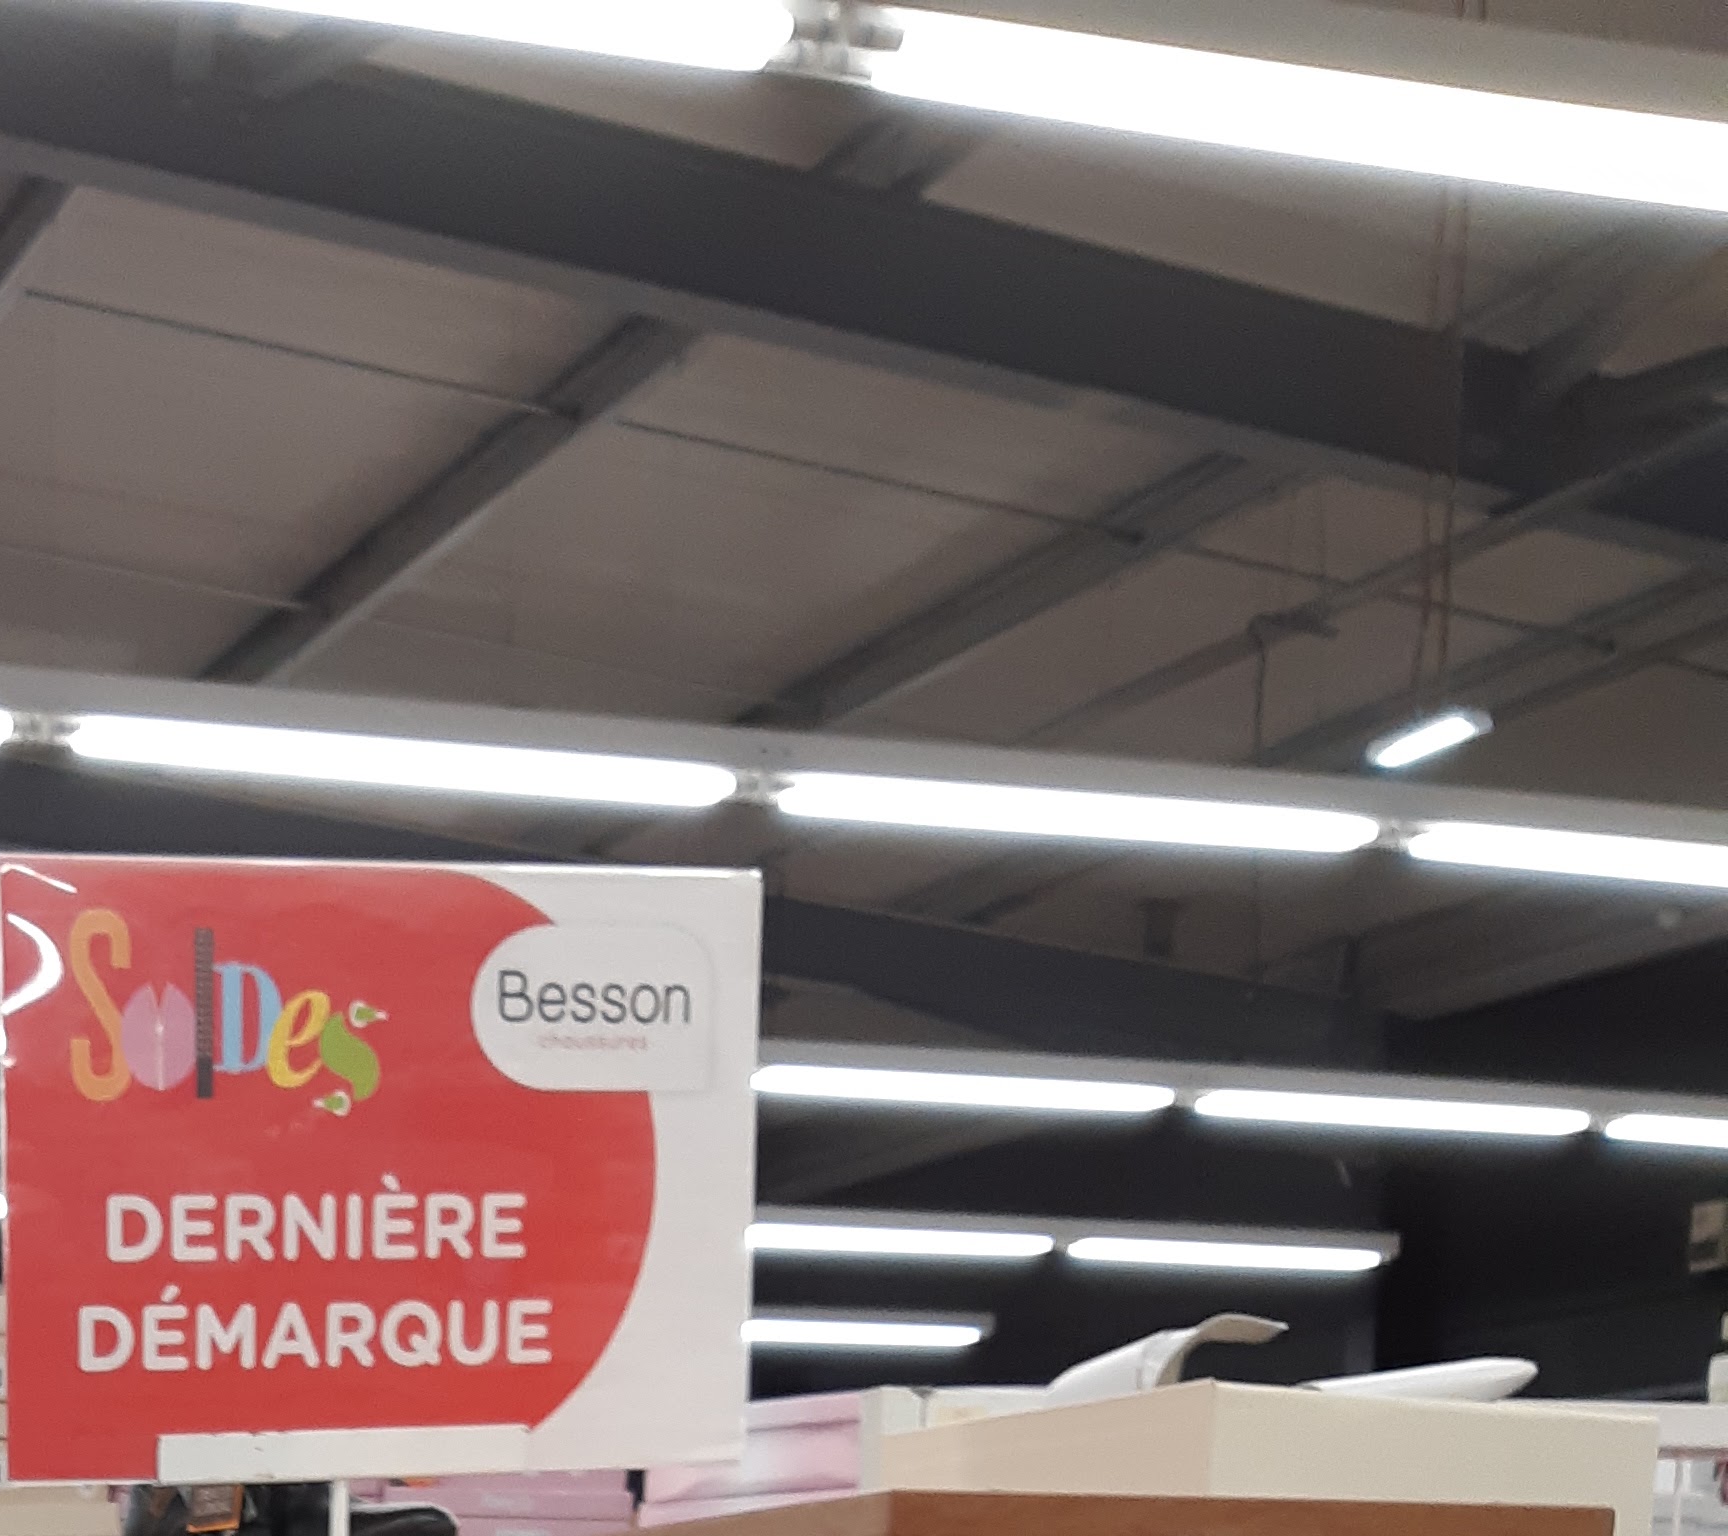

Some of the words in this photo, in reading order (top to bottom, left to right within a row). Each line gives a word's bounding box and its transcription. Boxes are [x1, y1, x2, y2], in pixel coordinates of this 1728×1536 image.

[498, 969, 691, 1024] Besson
[106, 1174, 527, 1263] DERNIÈRE
[77, 1285, 555, 1373] DÉMARQUE
